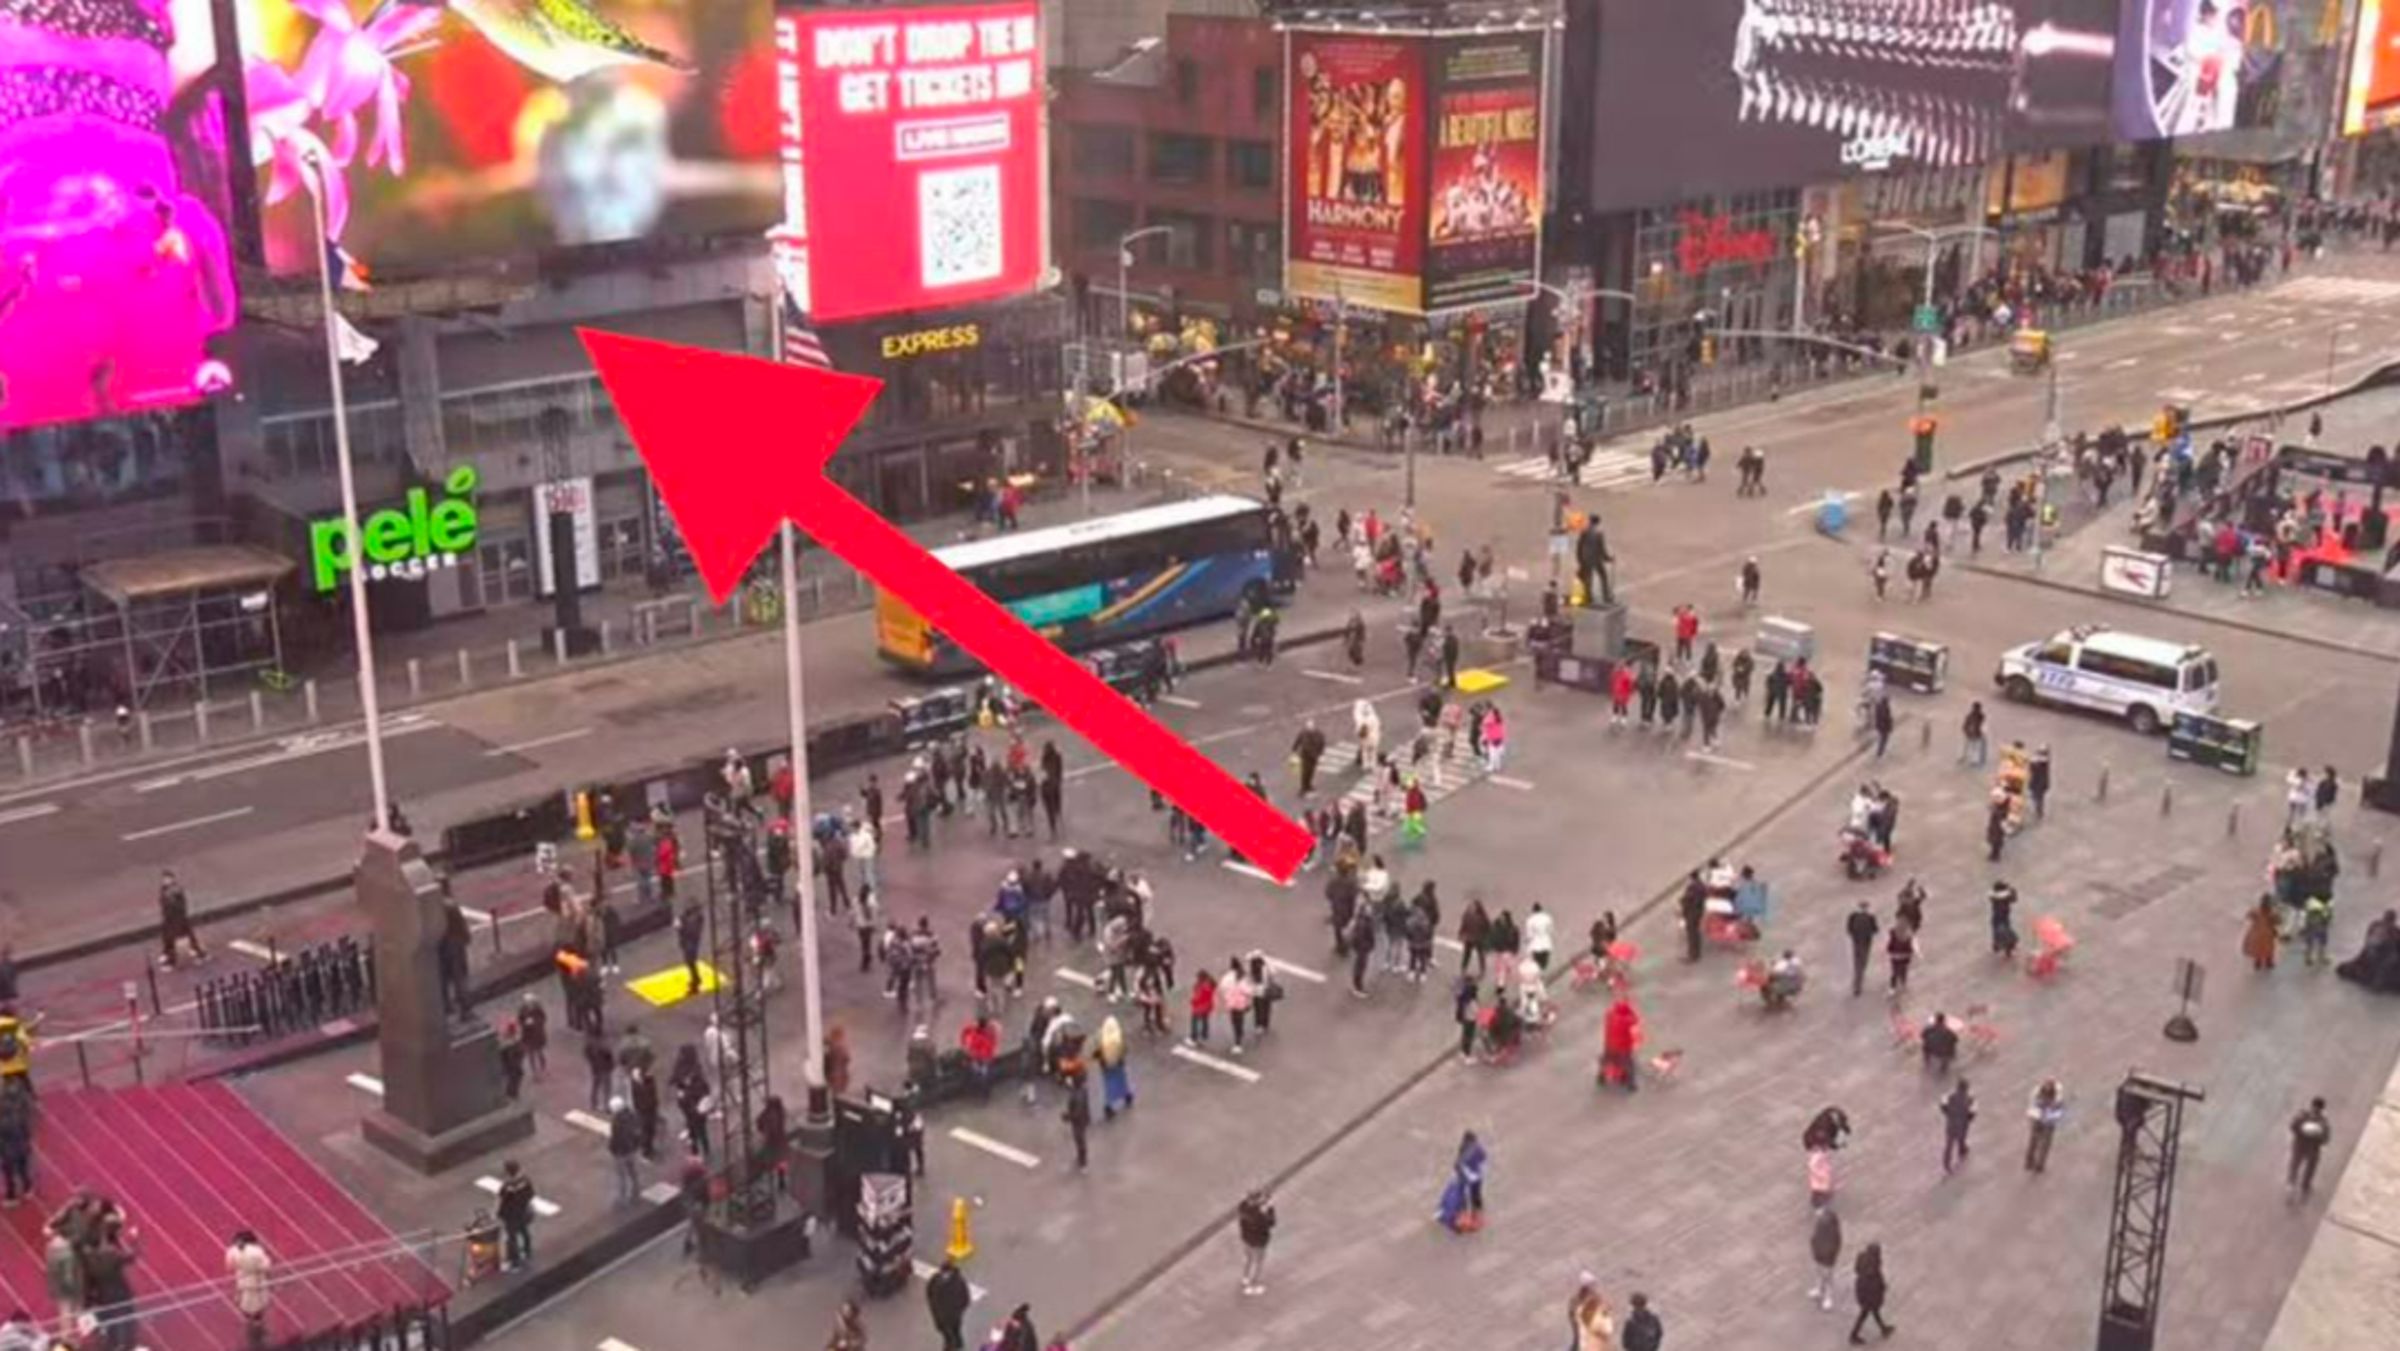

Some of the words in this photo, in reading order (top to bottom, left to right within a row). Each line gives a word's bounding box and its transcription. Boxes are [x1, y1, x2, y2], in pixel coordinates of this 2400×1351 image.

[838, 71, 892, 113] GET
[897, 64, 993, 109] TICKETS
[1306, 198, 1404, 233] HARMONY
[881, 324, 979, 358] EXPRESS
[311, 465, 477, 592] pelé
